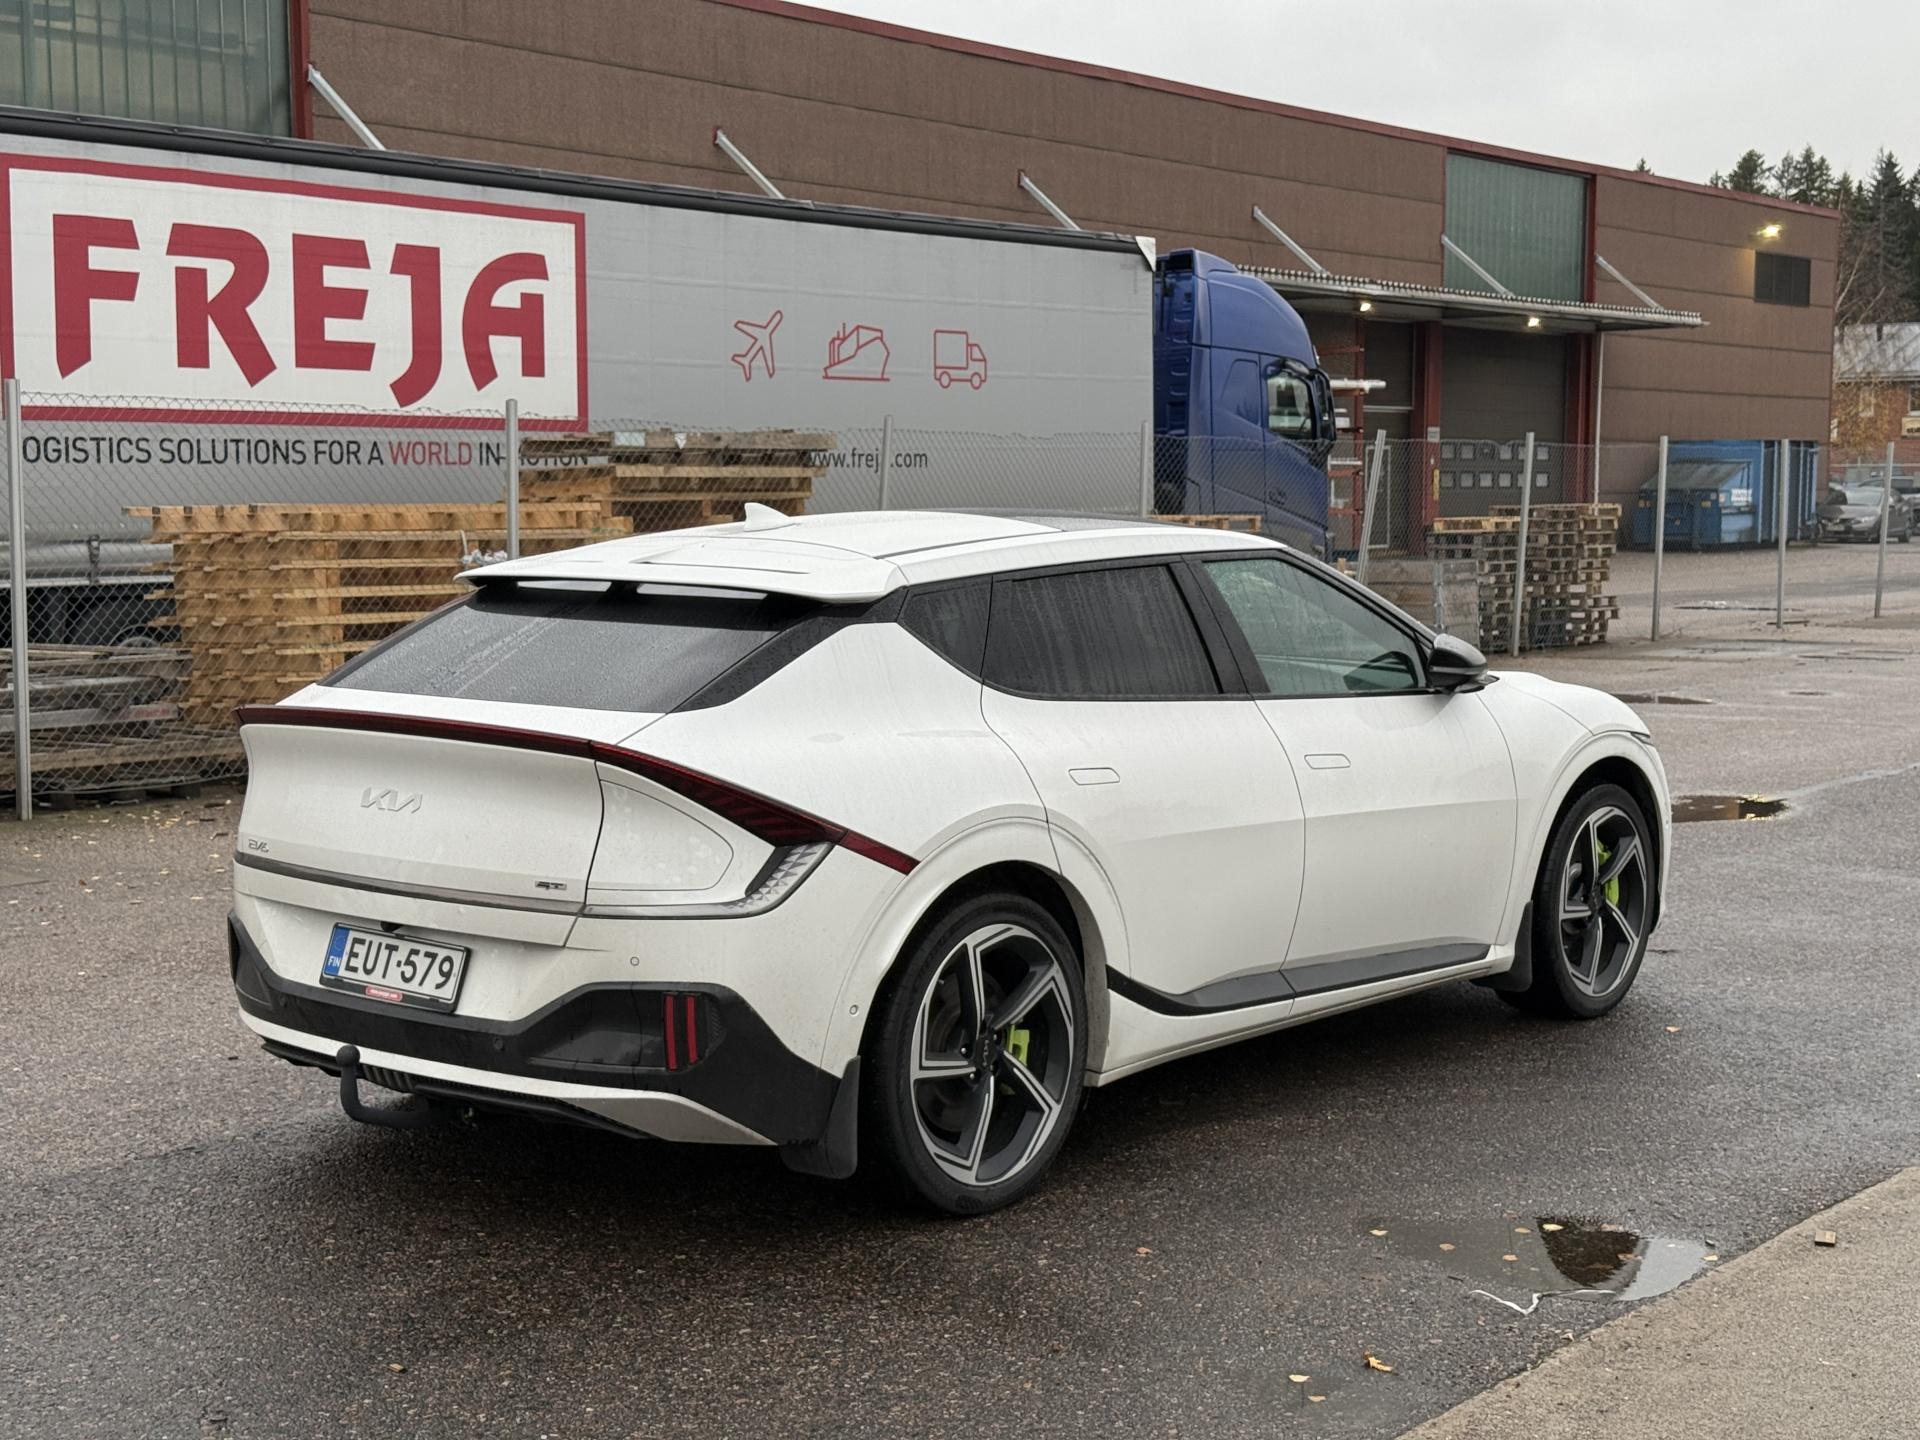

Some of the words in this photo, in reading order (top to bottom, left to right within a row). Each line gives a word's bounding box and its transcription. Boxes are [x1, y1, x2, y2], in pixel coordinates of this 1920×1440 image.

[53, 214, 547, 408] FREJA
[22, 435, 152, 464] OGISTICS
[159, 438, 307, 465] SOLUTIONS
[314, 440, 361, 466] FOR
[367, 441, 384, 466] A
[388, 441, 473, 467] WORLD
[808, 447, 928, 474] www.frej.com
[359, 785, 423, 814] KIA
[328, 955, 342, 968] FIN
[344, 936, 455, 990] EUT-579
